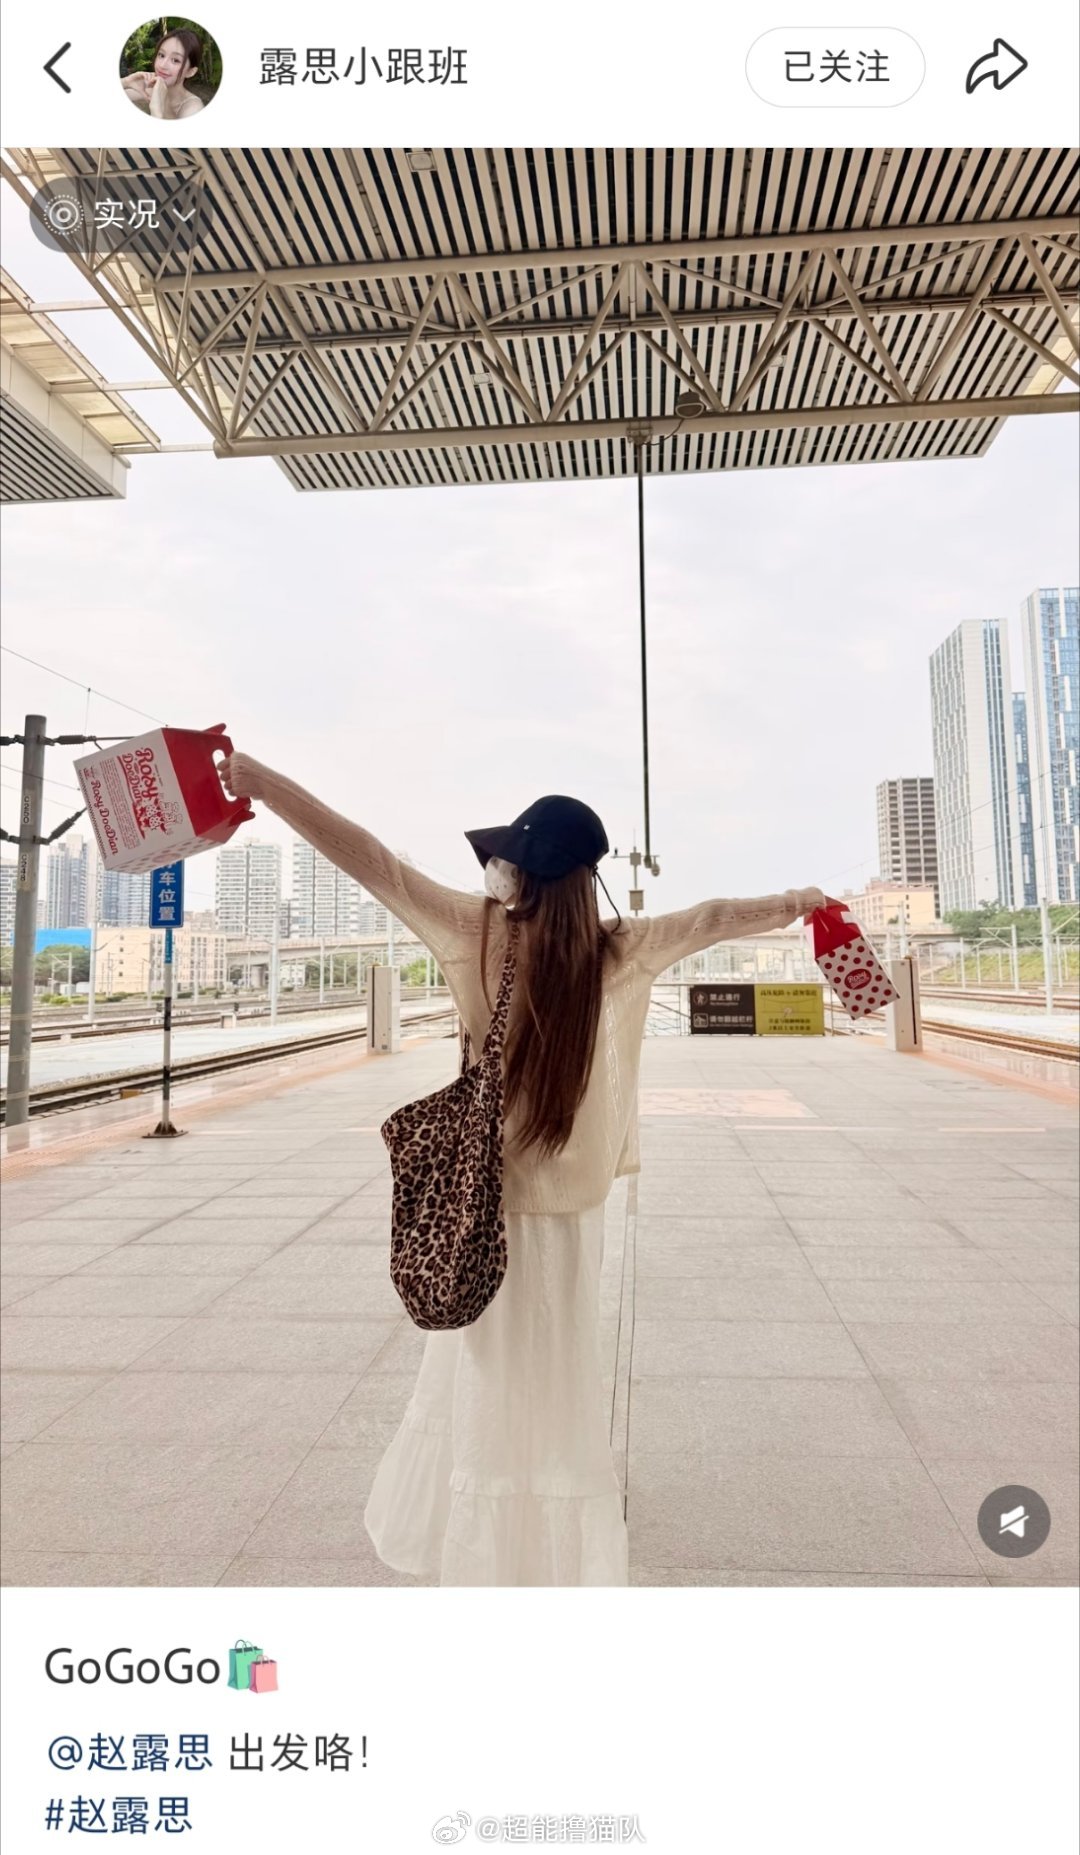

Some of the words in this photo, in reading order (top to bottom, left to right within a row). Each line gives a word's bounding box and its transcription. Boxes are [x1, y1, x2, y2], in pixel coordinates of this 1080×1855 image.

[91, 780, 104, 809] Rosy
[135, 747, 159, 800] Rosy
[158, 865, 176, 921] 车位置
